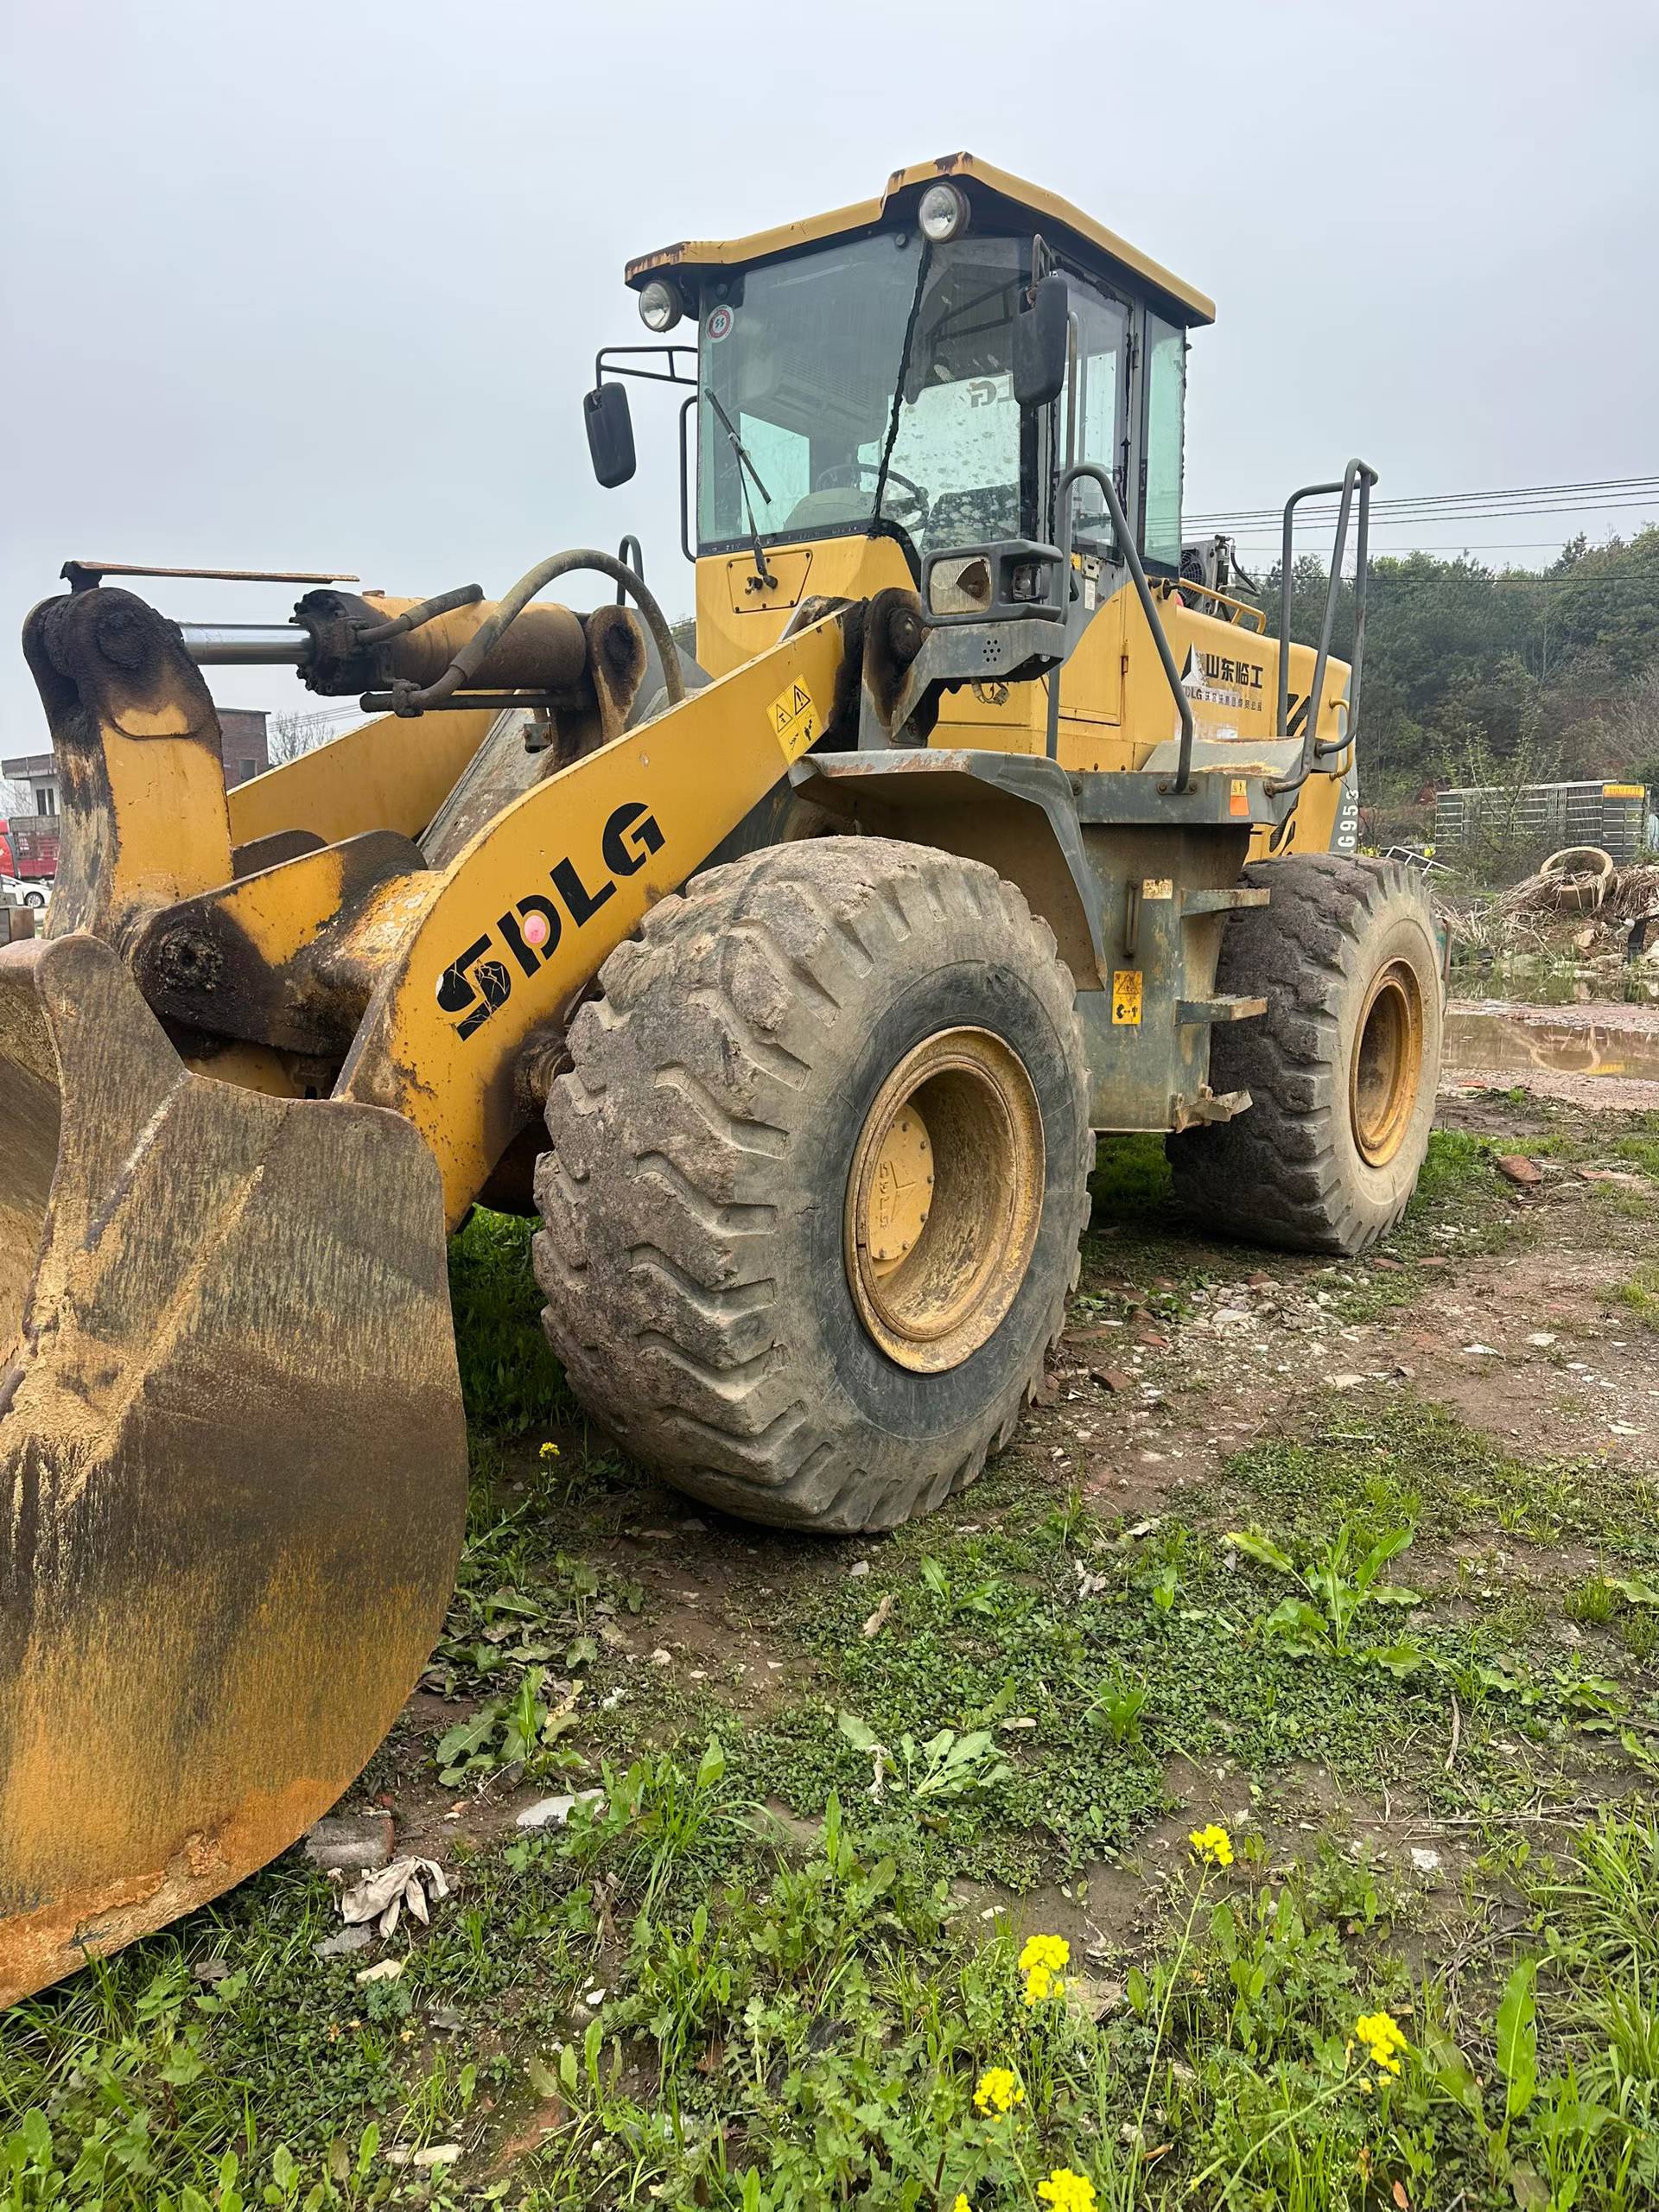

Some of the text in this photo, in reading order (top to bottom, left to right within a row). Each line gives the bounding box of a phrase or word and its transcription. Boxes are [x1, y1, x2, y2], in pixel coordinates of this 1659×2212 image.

[1206, 653, 1263, 689] 山东临工
[436, 802, 666, 1042] SDLG
